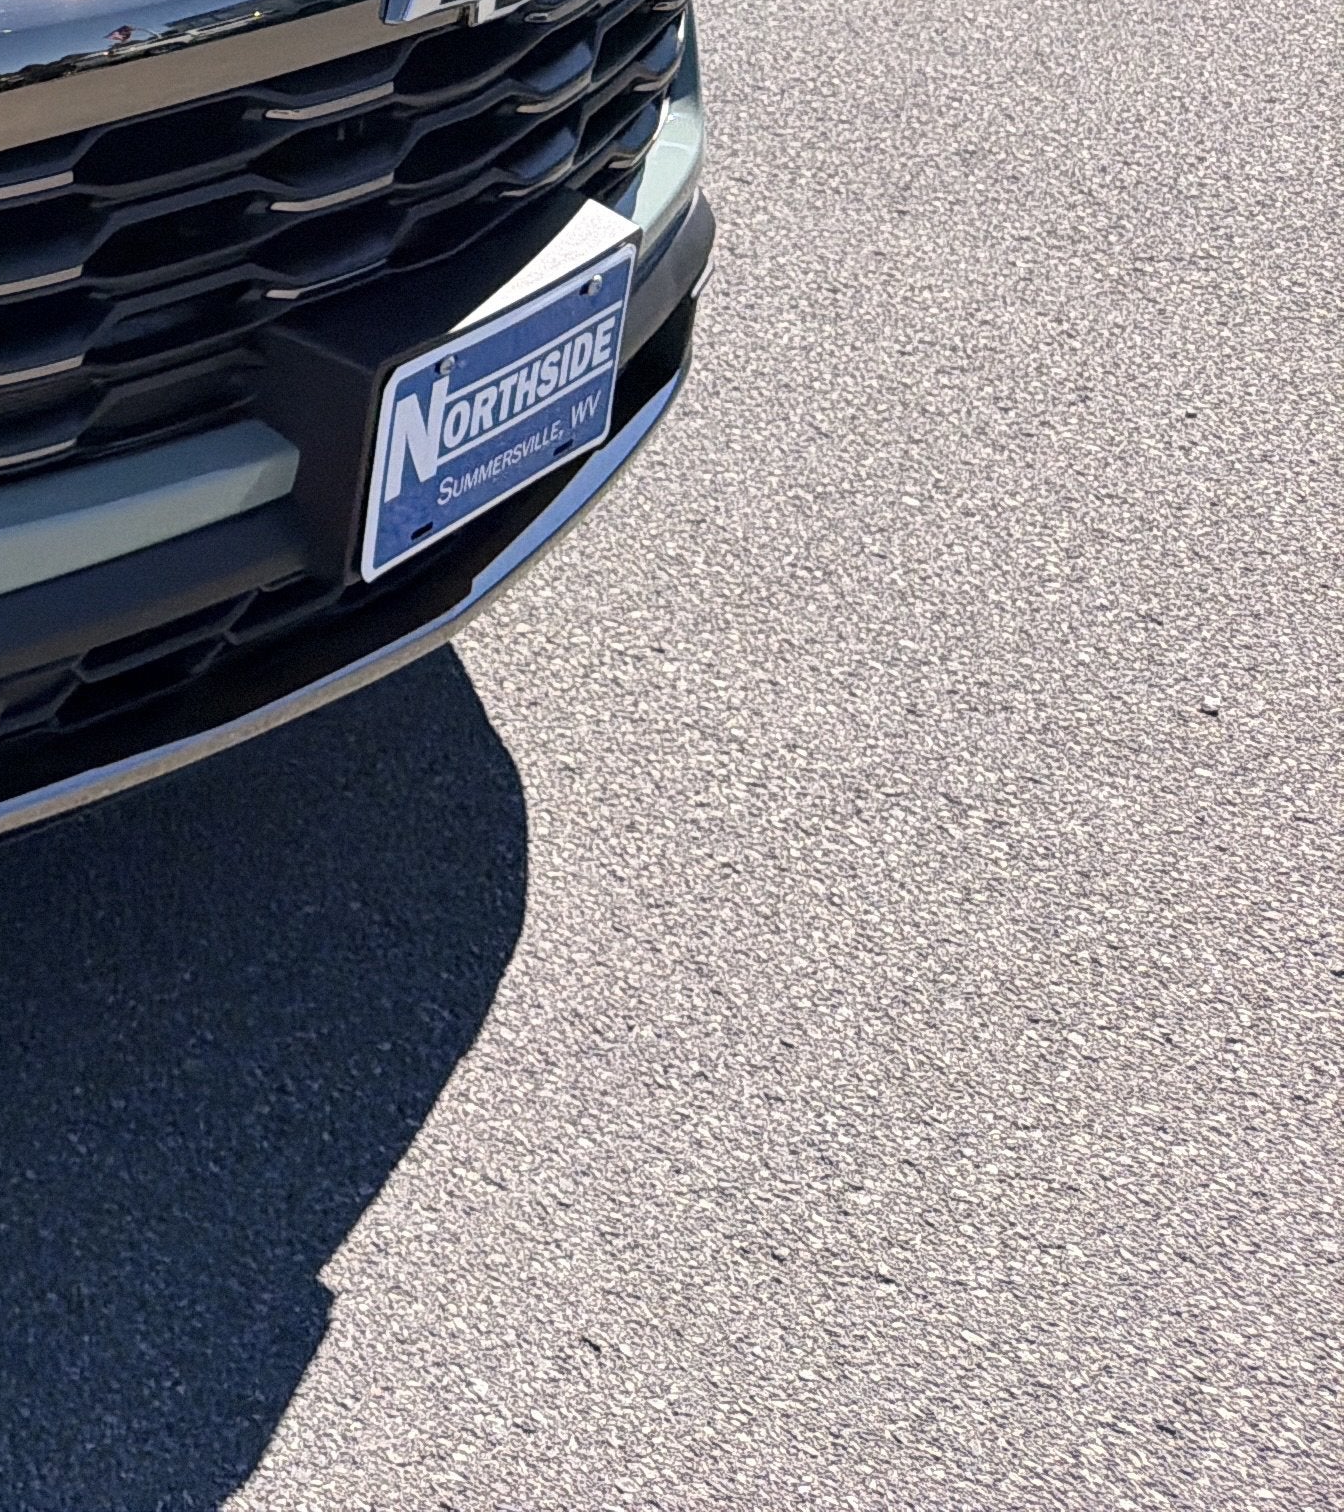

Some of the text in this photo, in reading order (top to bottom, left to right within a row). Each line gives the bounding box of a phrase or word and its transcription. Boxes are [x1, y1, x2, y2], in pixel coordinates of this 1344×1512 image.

[383, 315, 616, 504] NORTHSIDE
[436, 390, 602, 506] SUMMERSVILLE, WV
